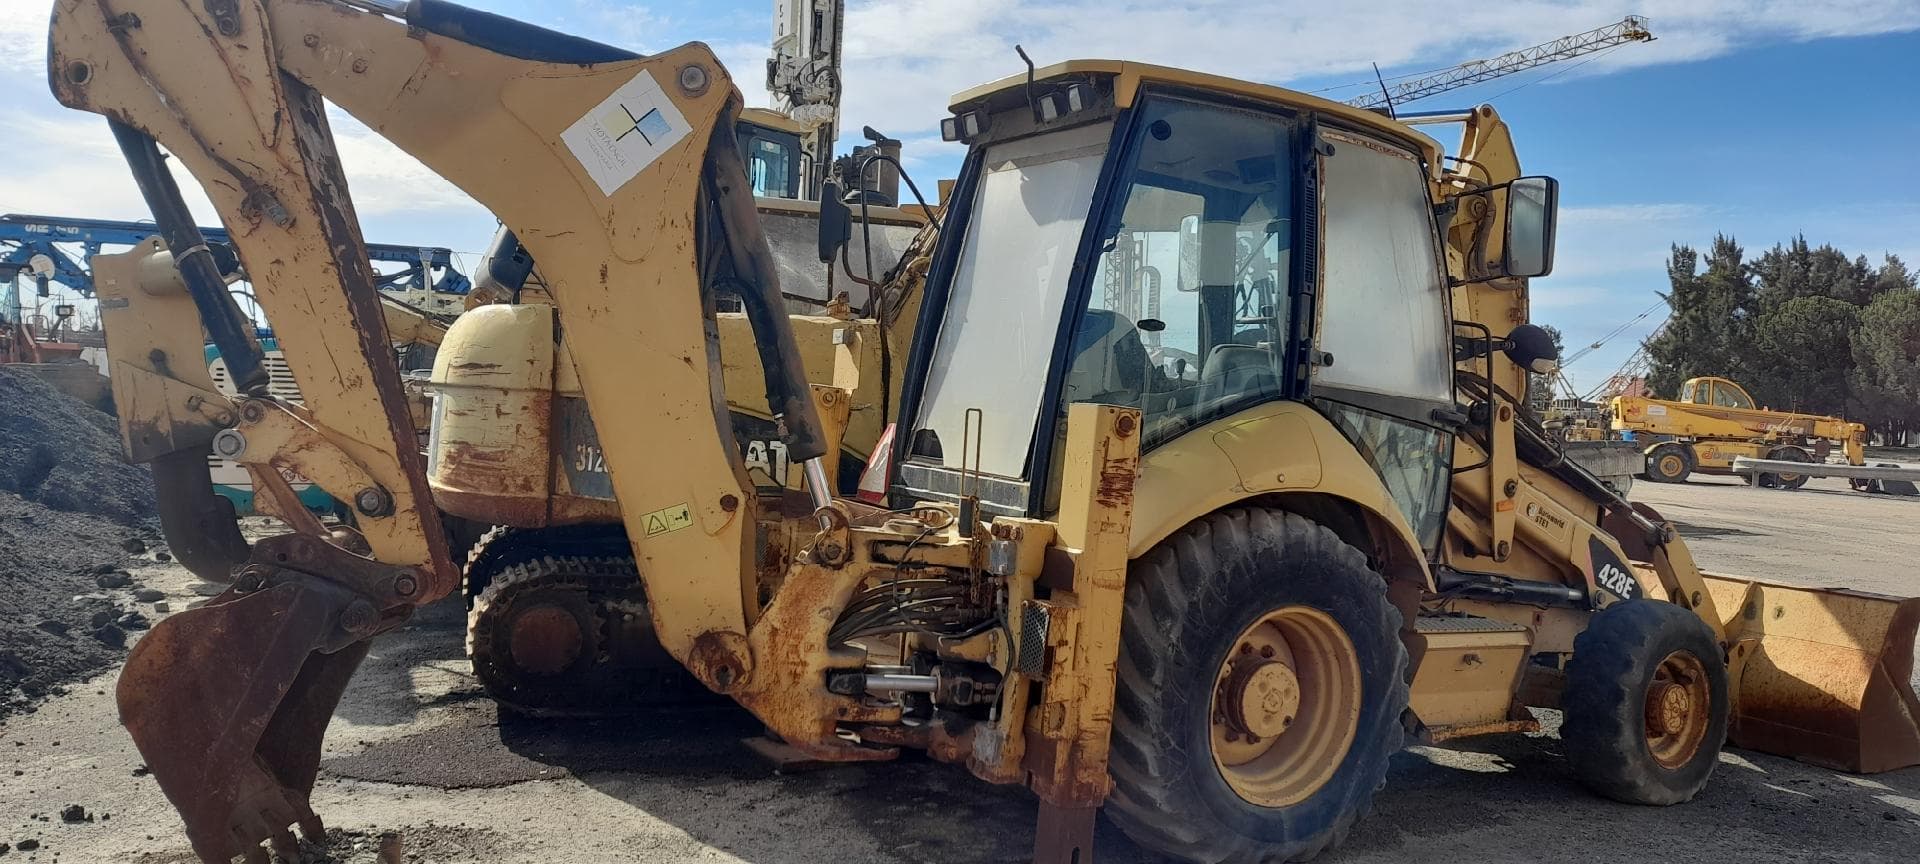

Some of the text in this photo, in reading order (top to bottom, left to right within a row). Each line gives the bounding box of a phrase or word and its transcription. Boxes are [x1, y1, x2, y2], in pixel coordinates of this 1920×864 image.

[575, 444, 608, 473] 312
[735, 440, 788, 486] AT
[1598, 563, 1636, 600] 428E
